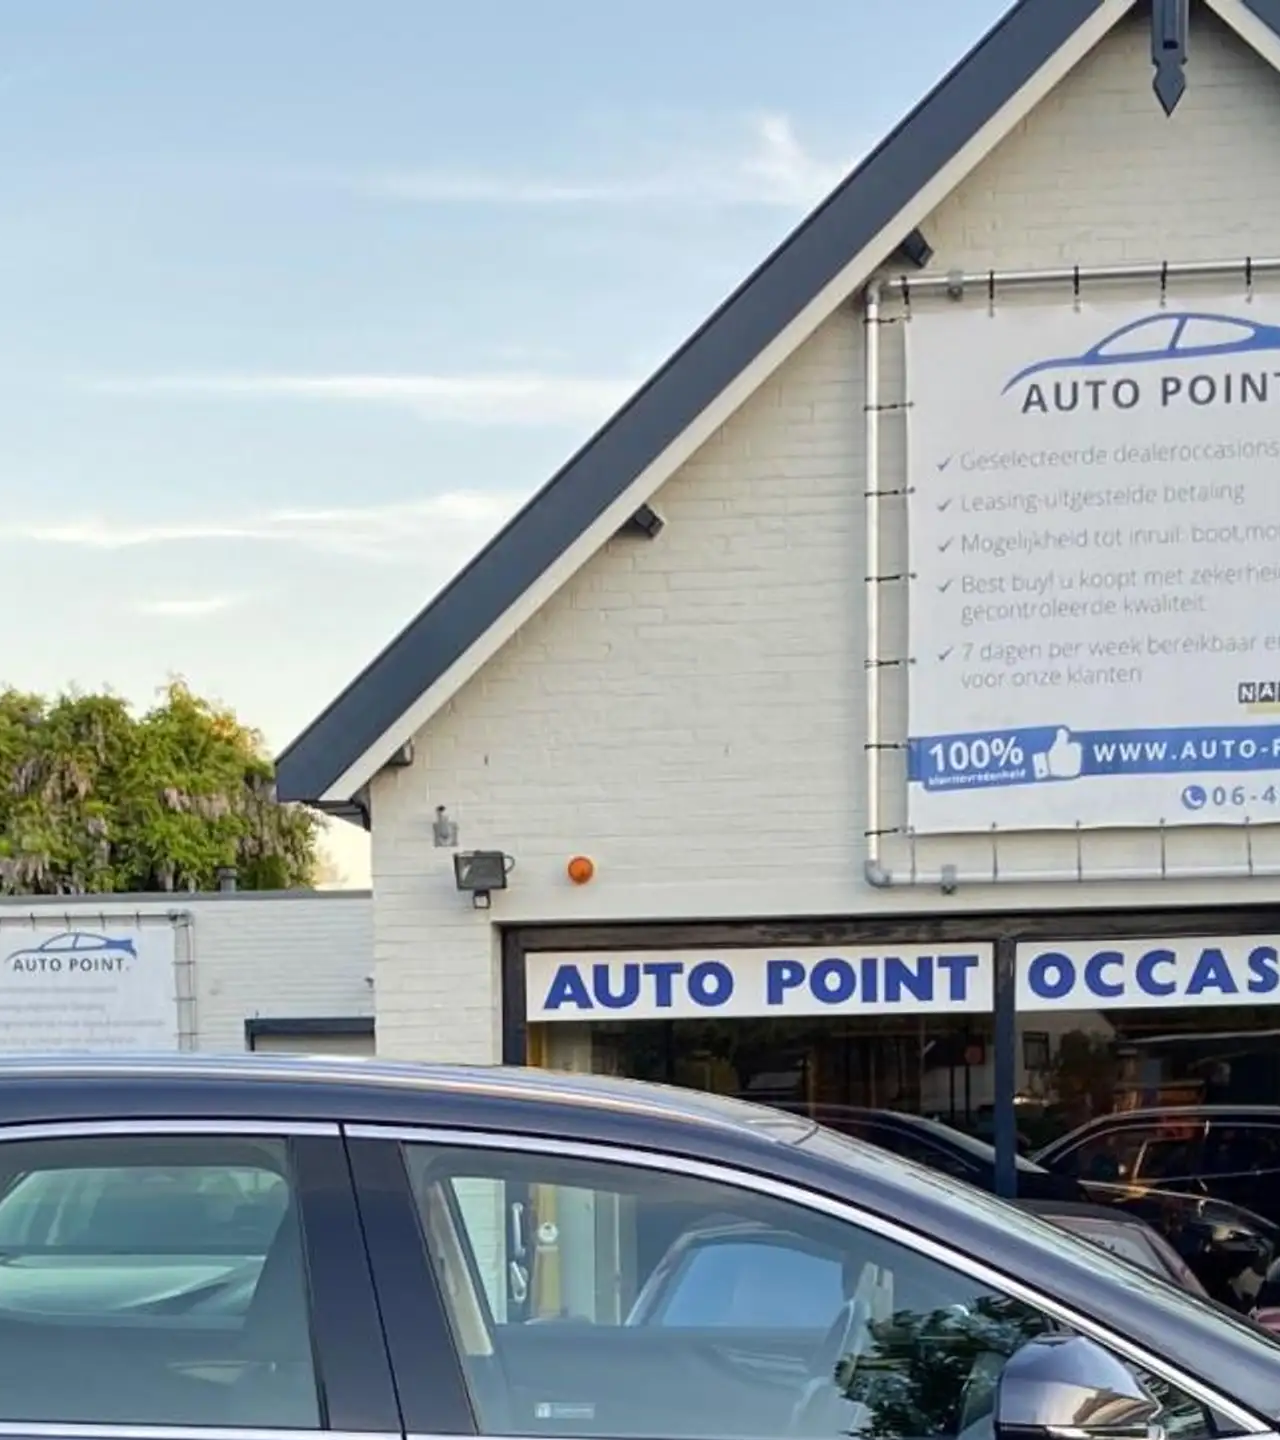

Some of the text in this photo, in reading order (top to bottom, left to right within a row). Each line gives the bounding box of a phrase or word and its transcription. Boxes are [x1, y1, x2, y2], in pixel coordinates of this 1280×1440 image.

[1022, 379, 1139, 413] AUTO
[960, 439, 1280, 471] Geselecteerde dealeroccasions
[1163, 482, 1245, 506] betaling
[961, 529, 1088, 557] Mogelijkheid
[1094, 529, 1122, 547] tot
[961, 575, 1005, 594] Best
[1060, 577, 1074, 590] u
[1079, 568, 1136, 592] koopt
[1144, 569, 1184, 587] met
[960, 594, 1207, 627] gecontroleerde kwaliteit
[961, 642, 975, 661] 7
[980, 641, 1042, 666] dagen
[1048, 643, 1081, 661] per
[1089, 638, 1140, 657] week
[1147, 631, 1257, 656] bereikbaar
[961, 664, 1143, 689] voor onze klanten
[928, 736, 1024, 772] 100%
[13, 958, 62, 972] AUTO
[543, 954, 980, 1012] AUTO POINT
